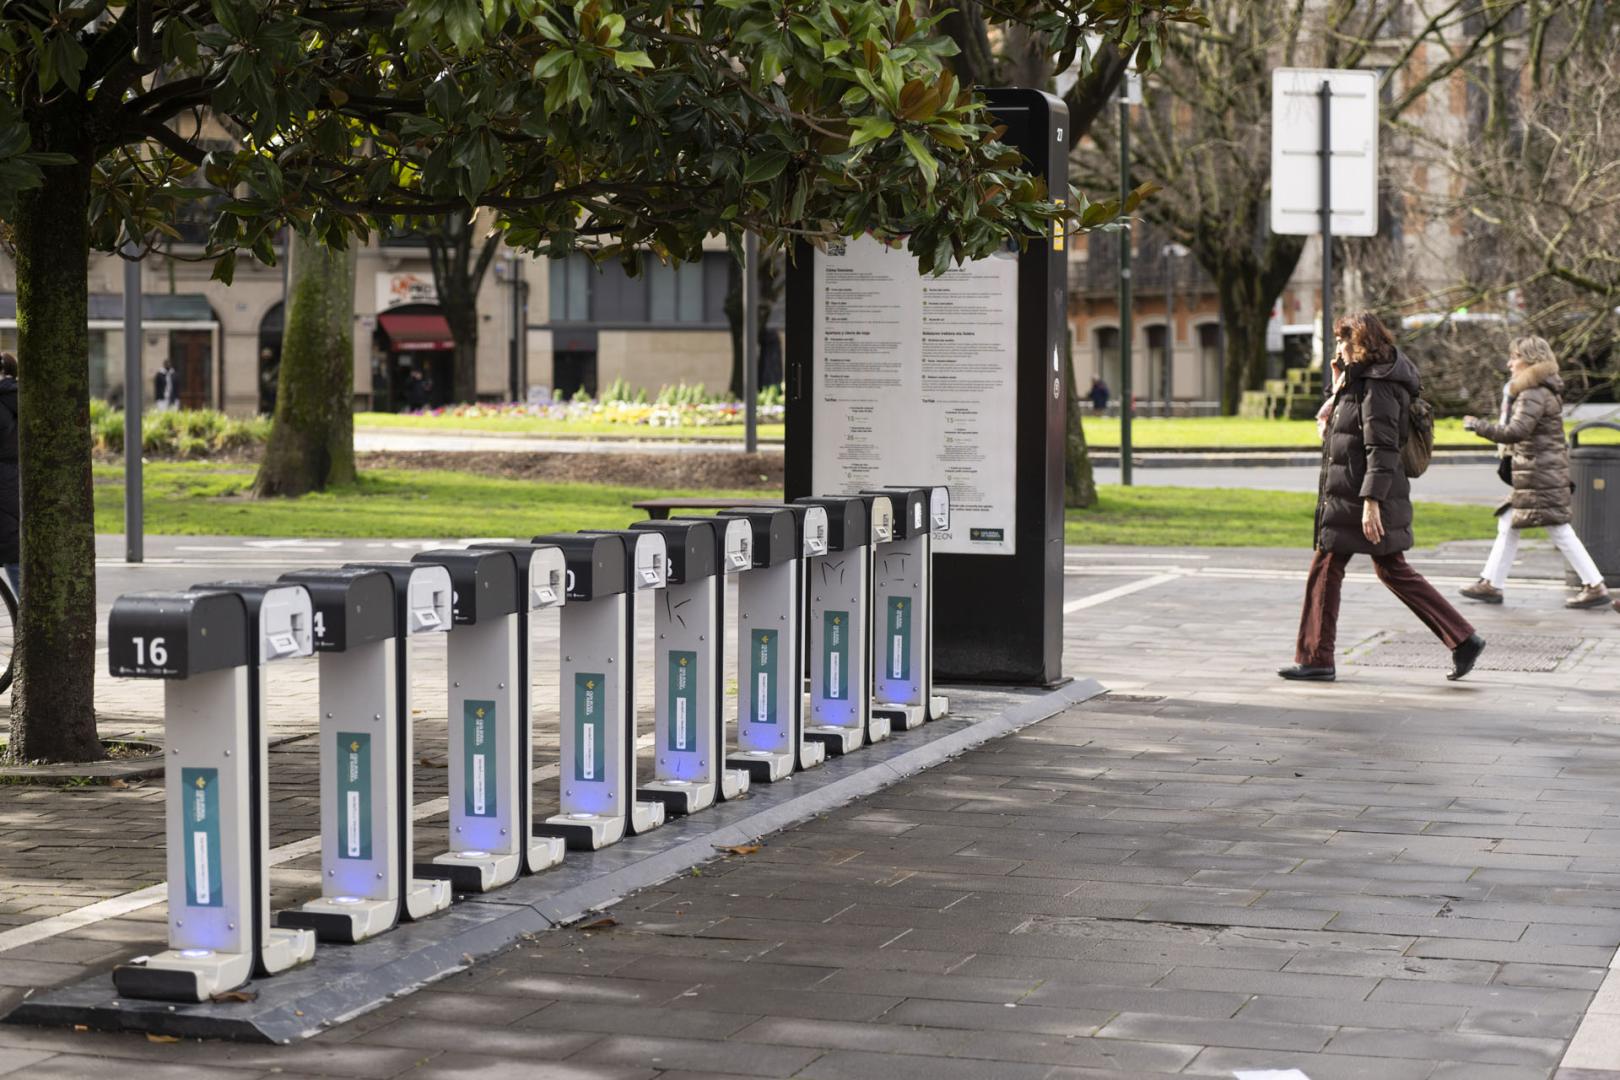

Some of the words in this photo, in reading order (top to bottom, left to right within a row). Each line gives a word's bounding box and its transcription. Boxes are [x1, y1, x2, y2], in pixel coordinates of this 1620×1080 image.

[567, 570, 575, 591] 0
[314, 611, 326, 638] 4
[132, 637, 168, 666] 16
